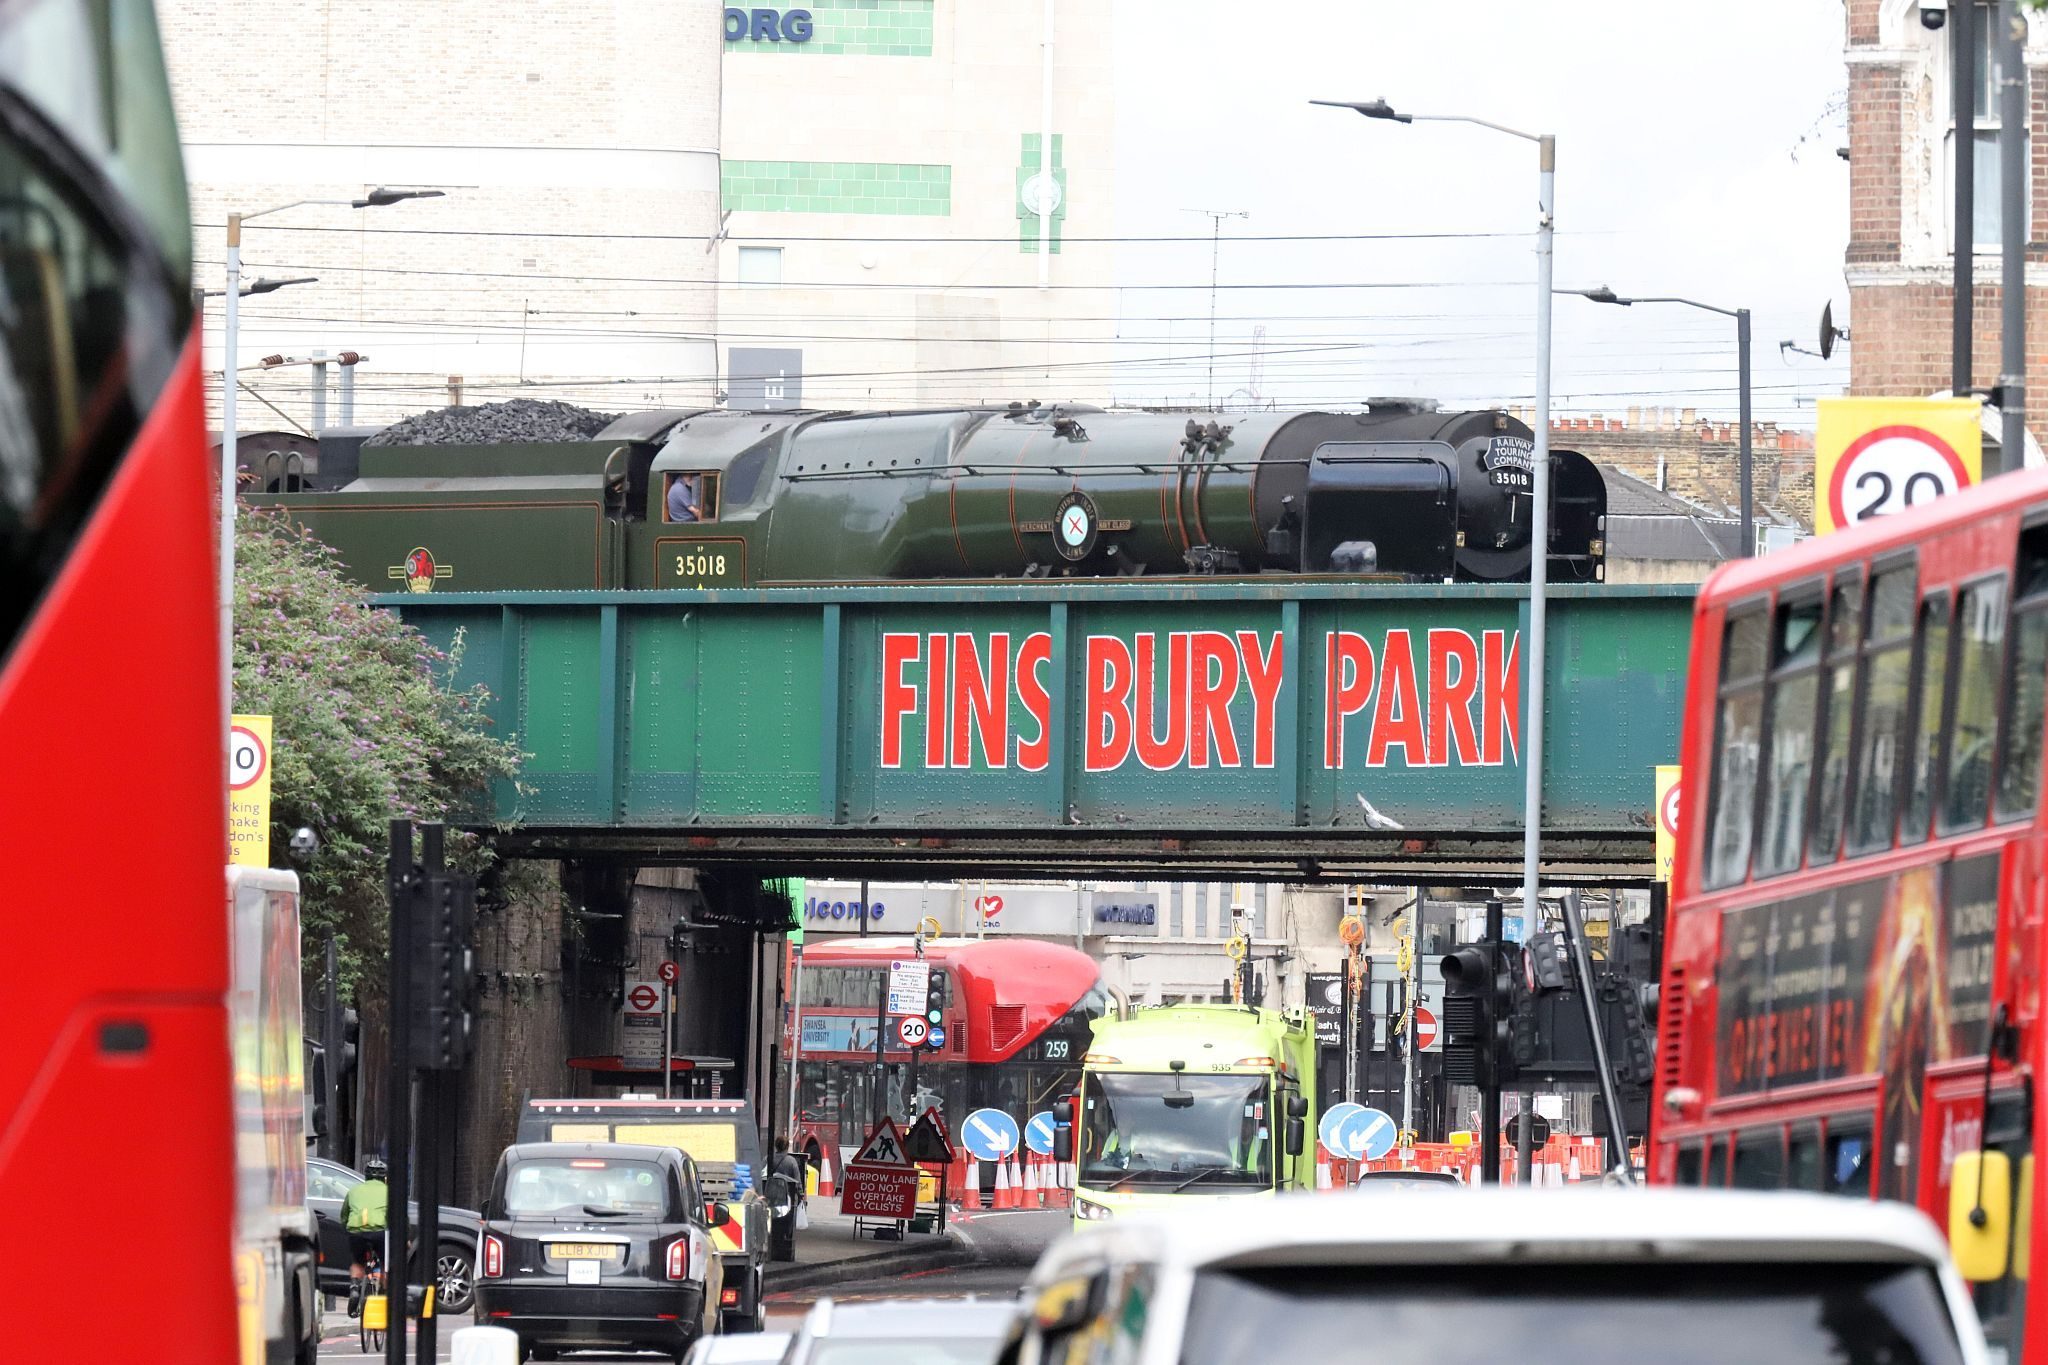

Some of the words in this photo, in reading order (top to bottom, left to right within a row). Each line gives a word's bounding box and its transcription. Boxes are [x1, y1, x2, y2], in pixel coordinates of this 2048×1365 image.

[1496, 437, 1534, 450] RAILWAY
[1496, 472, 1528, 486] 35018
[1066, 547, 1084, 557] LINE
[675, 555, 726, 576] 35018
[1324, 628, 1520, 769] PARK
[804, 897, 885, 920] lcome
[664, 964, 675, 980] S
[803, 1019, 827, 1030] SWANSEA
[903, 1024, 925, 1037] 20
[803, 1031, 830, 1043] UNIVERSITY
[1046, 1041, 1069, 1058] 259
[1211, 1063, 1231, 1072] 935
[845, 1171, 889, 1182] NARROW
[892, 1175, 918, 1185] LANE
[860, 1182, 875, 1191] DO
[878, 1183, 900, 1193] NOT
[853, 1191, 905, 1203] OVERTAKE
[854, 1201, 902, 1213] CYCLISTS
